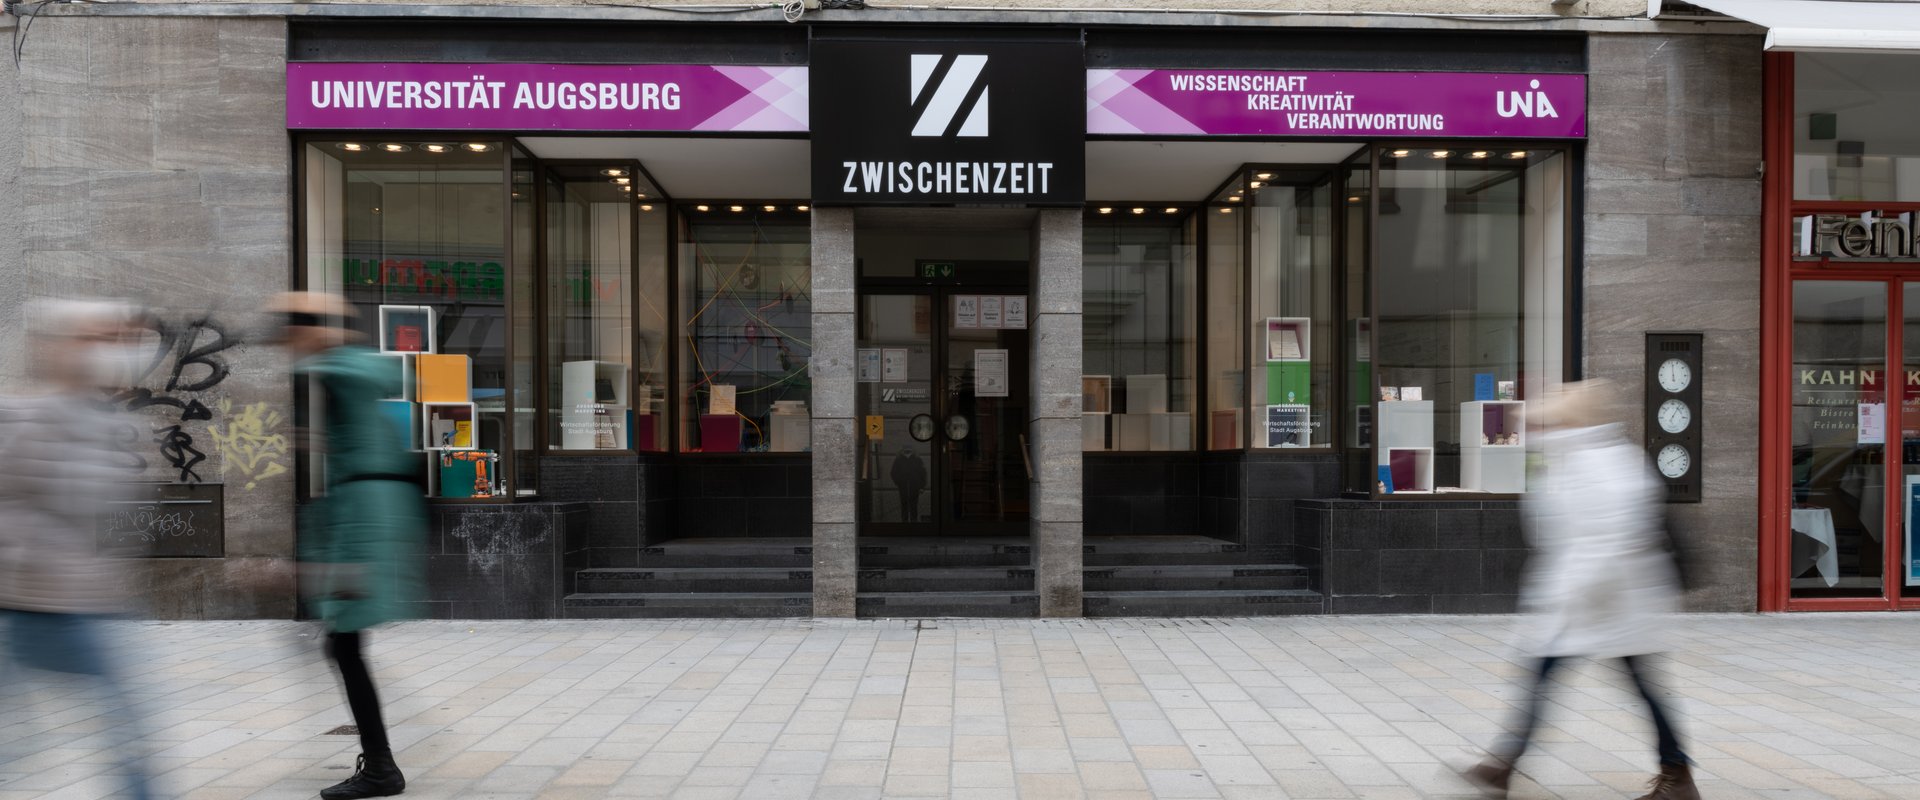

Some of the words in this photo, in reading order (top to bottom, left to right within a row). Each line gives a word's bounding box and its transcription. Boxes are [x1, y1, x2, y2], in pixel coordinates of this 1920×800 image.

[311, 75, 506, 110] UNIVERSITÄT
[512, 82, 681, 111] AUGSBURG
[1169, 74, 1308, 93] WISSENSCHAFT
[1247, 91, 1355, 111] KREATIVITÄT
[1286, 112, 1444, 131] VERANTWORTUNG
[843, 161, 1053, 194] ZWISCHENZEIT
[1801, 370, 1875, 385] KAHN
[1820, 409, 1854, 417] Bistro
